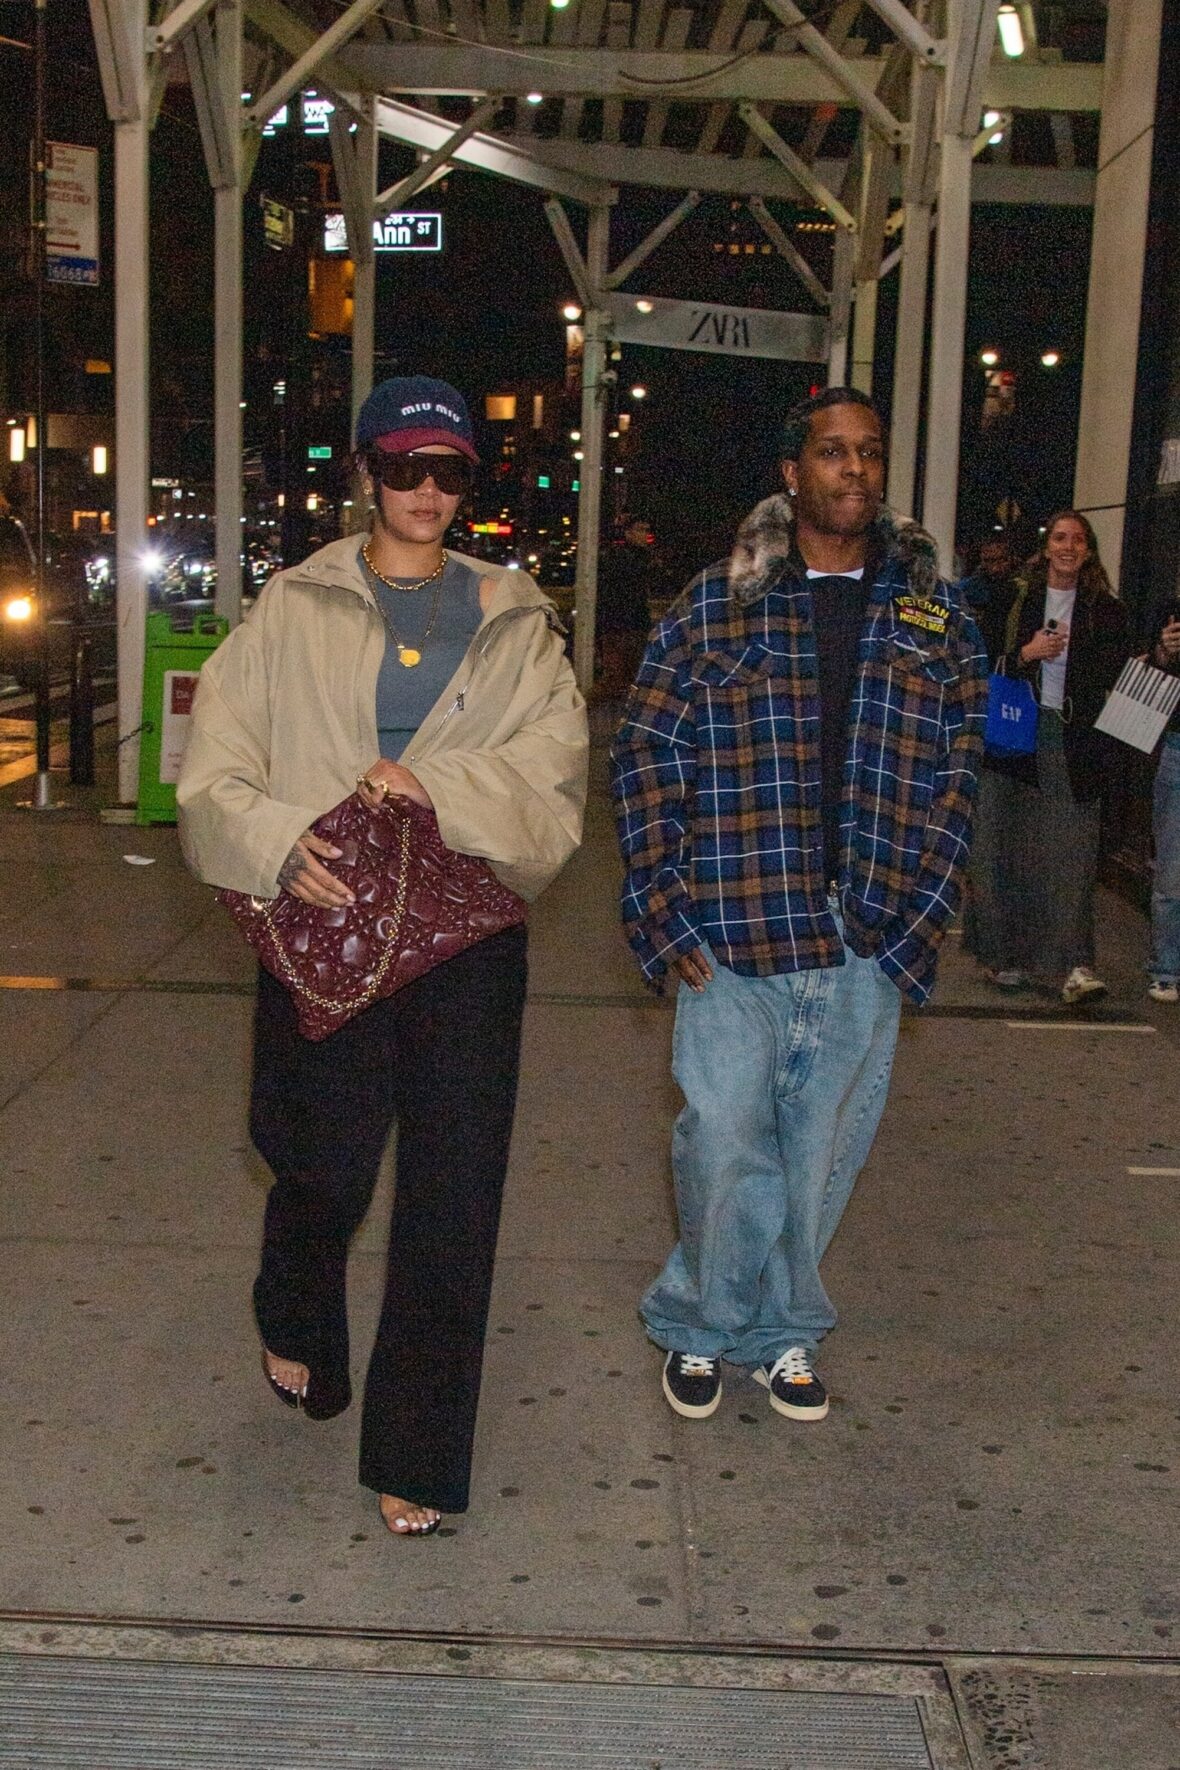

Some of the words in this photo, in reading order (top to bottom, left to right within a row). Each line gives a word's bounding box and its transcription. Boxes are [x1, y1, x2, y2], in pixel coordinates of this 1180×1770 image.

[373, 221, 411, 245] Ann
[688, 312, 750, 348] ZARA
[895, 596, 949, 619] VETERAN
[1001, 703, 1022, 722] GAP
